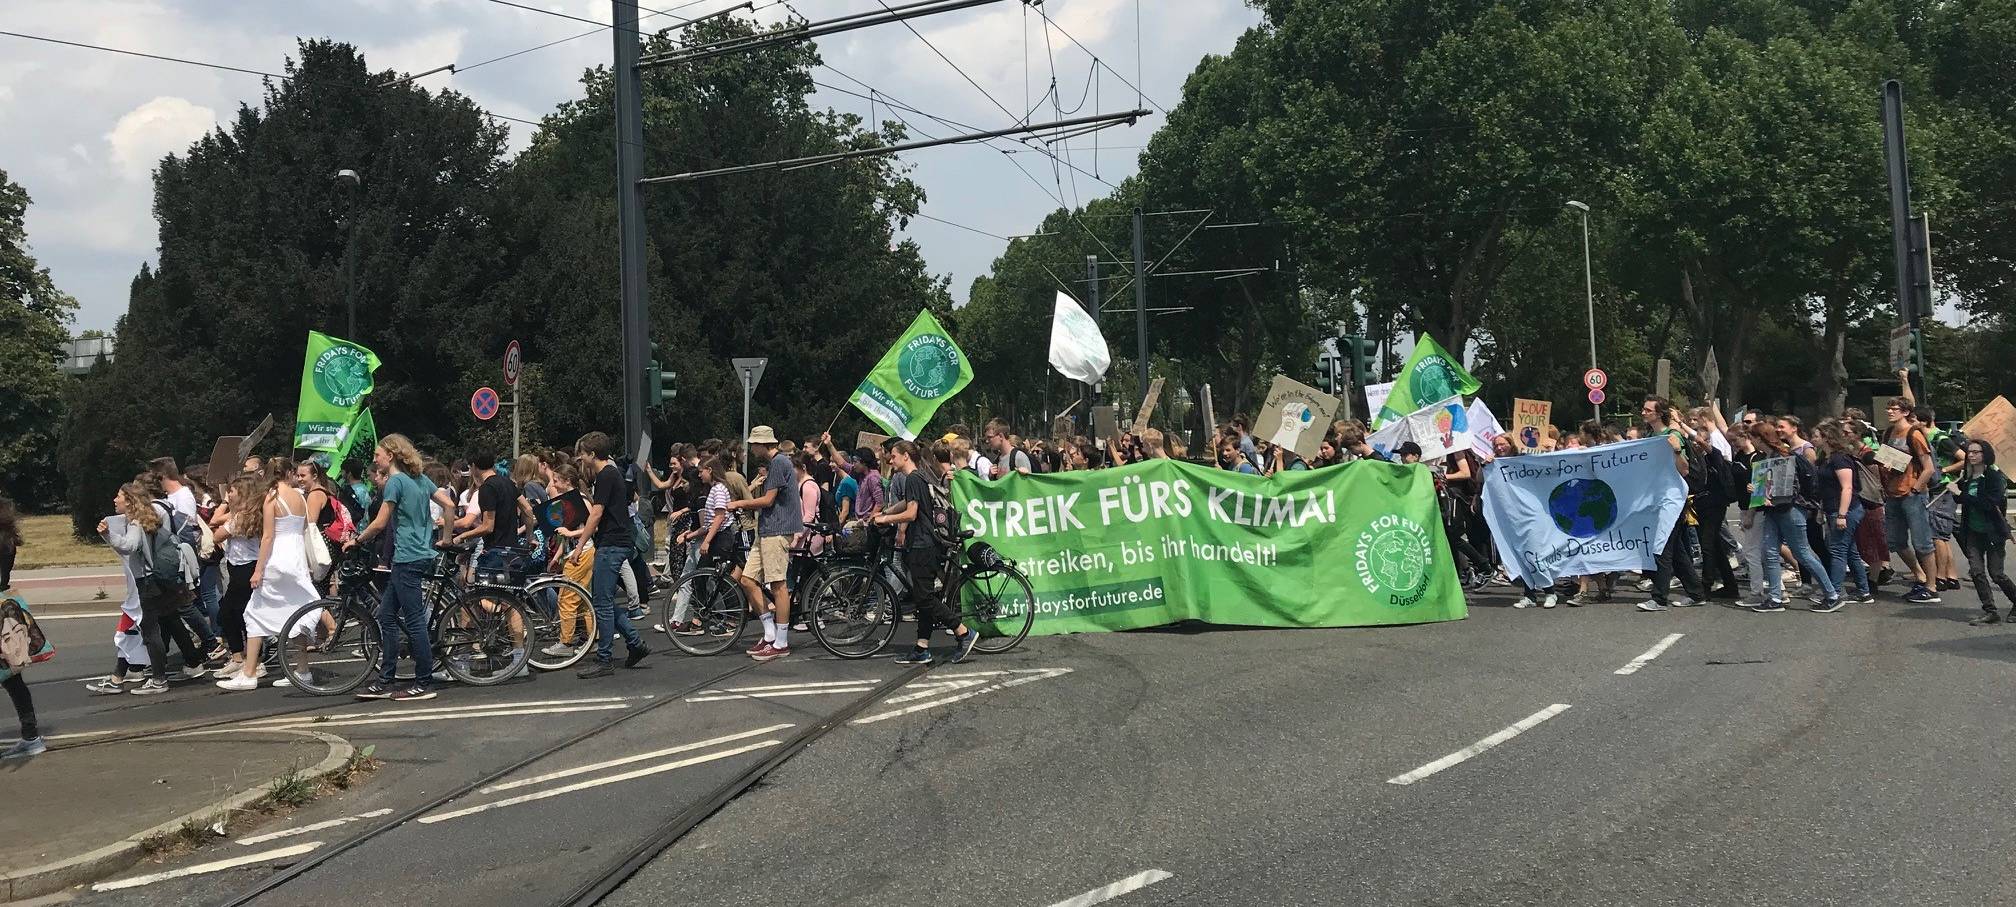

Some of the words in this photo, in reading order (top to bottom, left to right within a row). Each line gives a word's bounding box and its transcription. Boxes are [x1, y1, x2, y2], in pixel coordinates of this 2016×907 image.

[315, 346, 348, 373] FRIDAYS
[508, 352, 517, 373] 60
[907, 335, 946, 351] FRIDAYS
[945, 345, 959, 366] FOR
[1415, 356, 1447, 373] FRIDAYS
[904, 378, 940, 398] FUTURE
[1589, 374, 1602, 385] 60
[871, 387, 886, 401] Wir
[885, 399, 908, 424] streiken,
[1521, 402, 1548, 415] LOVE
[308, 424, 324, 432] Wir
[1518, 414, 1546, 426] YOUR
[1500, 463, 1552, 482] Fridays
[1557, 459, 1584, 477] for
[1591, 450, 1648, 472] Future
[965, 492, 1086, 538] STREIK
[1098, 475, 1192, 526] FÜRS
[1208, 486, 1337, 530] KLIMA!
[1020, 548, 1114, 577] streiken,
[1121, 540, 1155, 566] bis
[1161, 534, 1187, 559] ihr
[1189, 534, 1277, 567] handelt!
[1355, 532, 1380, 593] FRIDAYS
[1371, 514, 1399, 533] FOR
[1402, 517, 1432, 565] FUTURE
[1390, 574, 1430, 607] Düsseldorf
